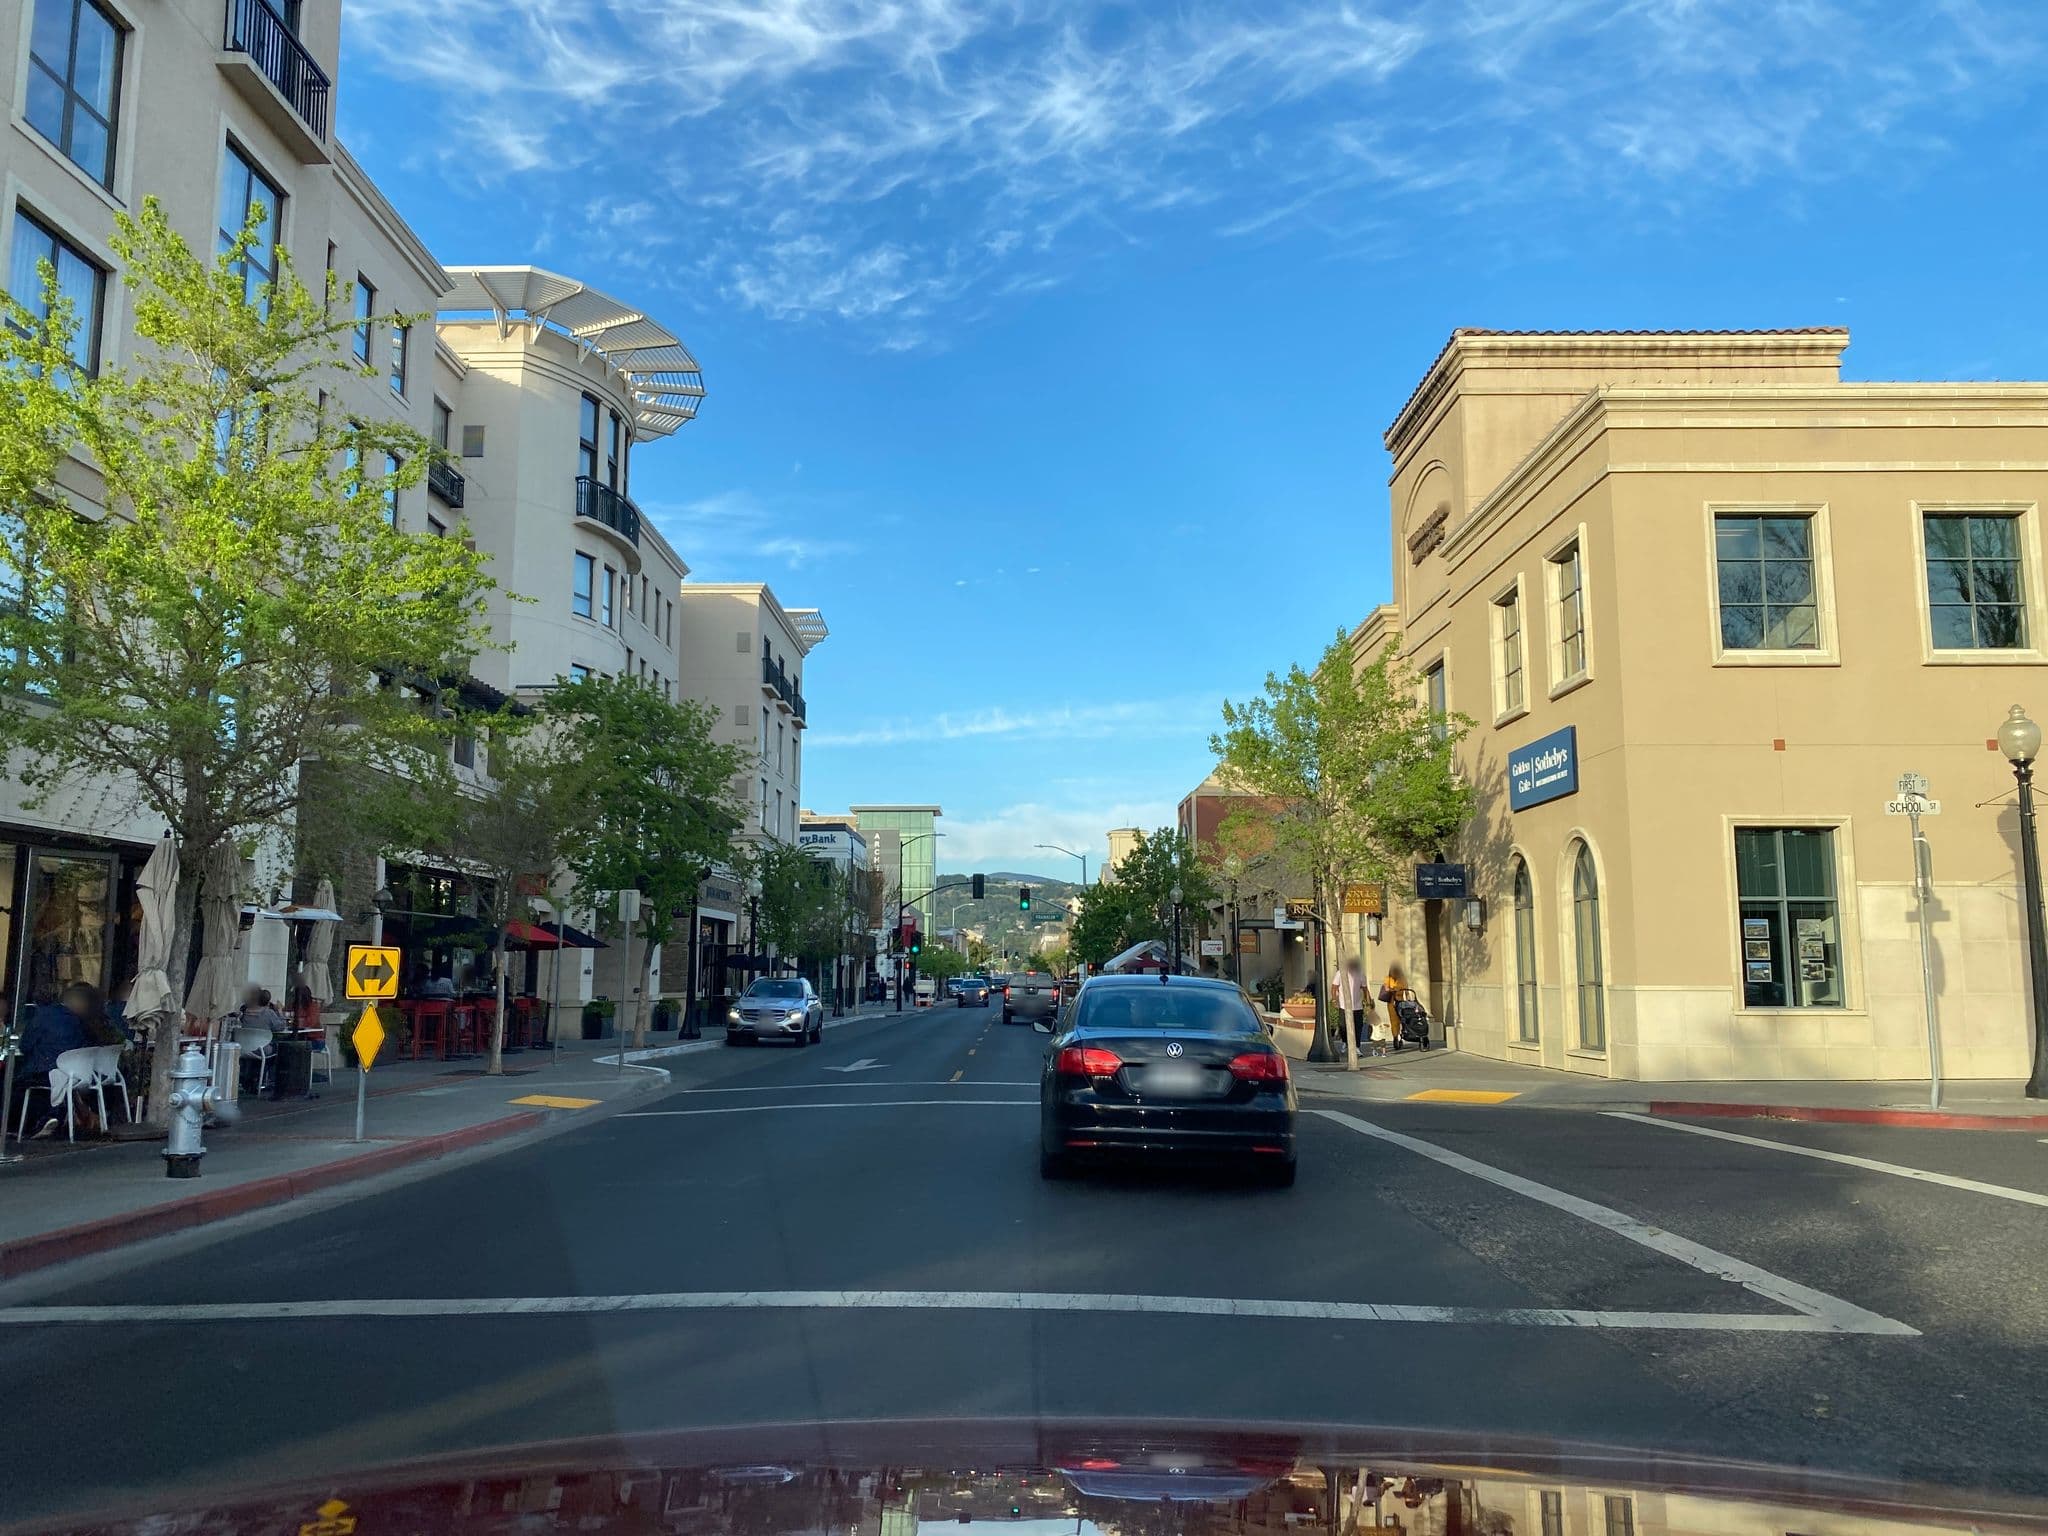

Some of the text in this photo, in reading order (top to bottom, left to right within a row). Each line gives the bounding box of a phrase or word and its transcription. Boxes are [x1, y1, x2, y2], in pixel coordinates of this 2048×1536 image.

[1535, 748, 1567, 773] Sotheby's
[1513, 761, 1531, 776] Golden
[1518, 779, 1532, 793] Gate
[1899, 780, 1915, 791] FIRST
[1890, 802, 1924, 812] SCHOOL
[811, 833, 836, 844] Bank
